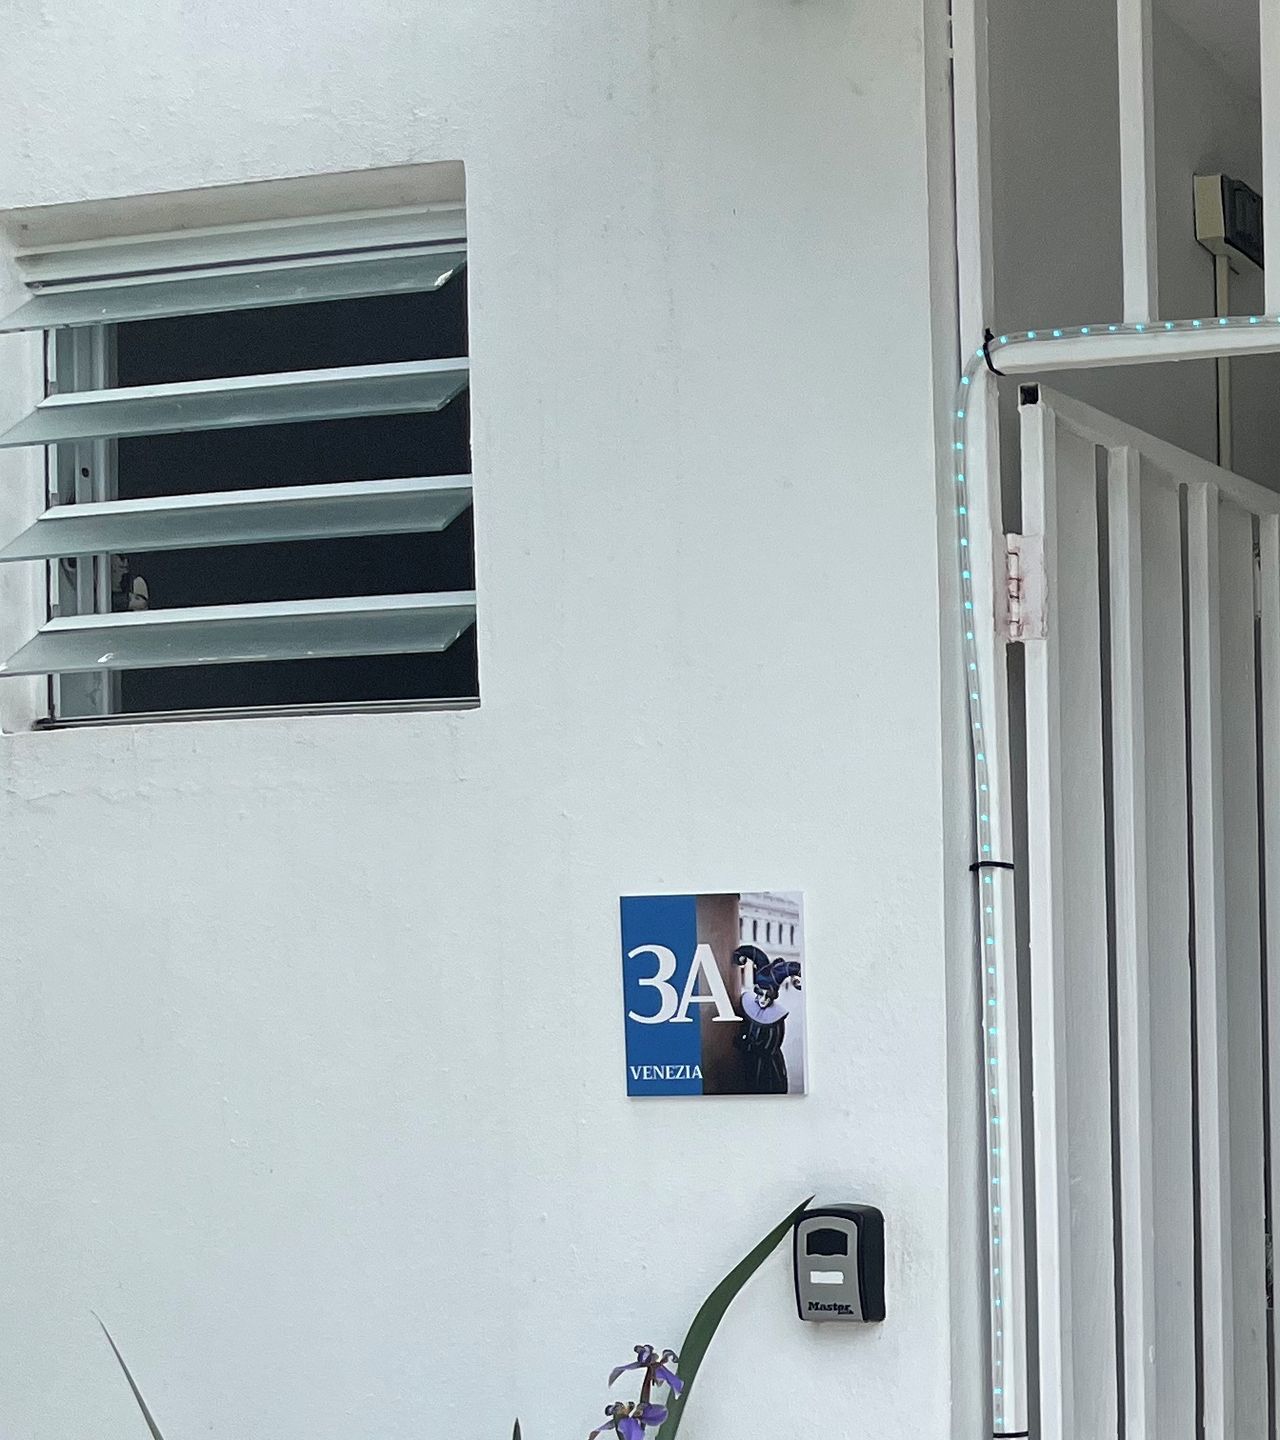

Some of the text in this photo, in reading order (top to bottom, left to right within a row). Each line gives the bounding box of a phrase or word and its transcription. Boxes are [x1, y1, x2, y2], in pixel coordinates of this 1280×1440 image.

[627, 943, 744, 1024] 3A
[630, 1064, 704, 1080] VENEZIA
[808, 1301, 851, 1312] Master
